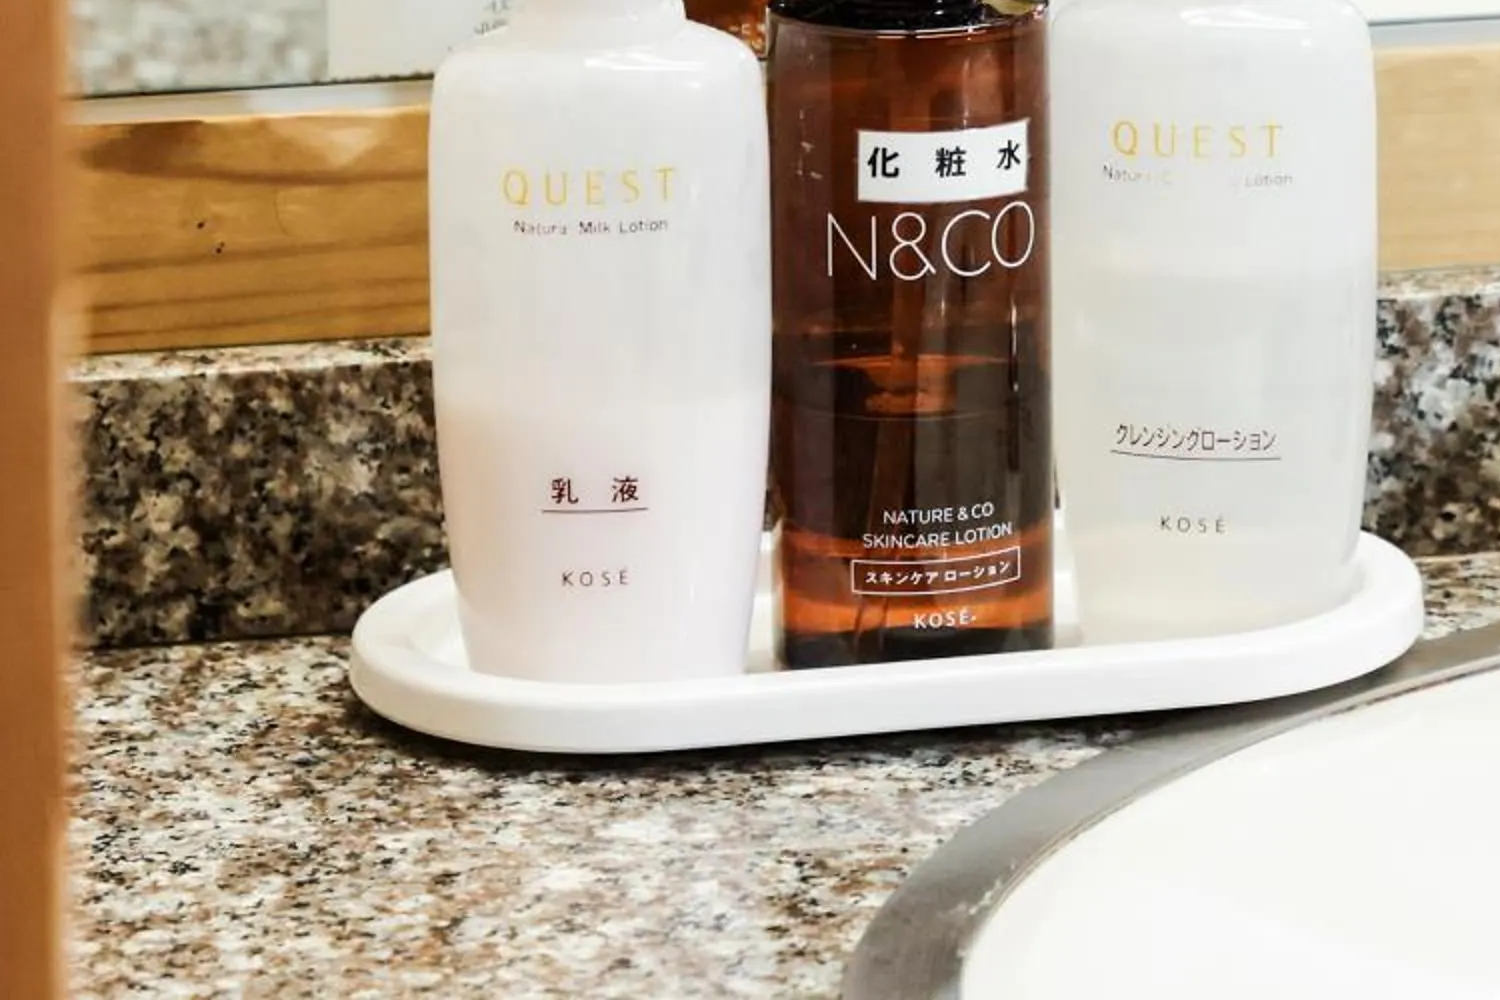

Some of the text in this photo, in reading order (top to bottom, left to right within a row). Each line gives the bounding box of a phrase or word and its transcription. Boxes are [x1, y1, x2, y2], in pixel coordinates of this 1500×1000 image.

[1112, 119, 1283, 159] QUEST
[867, 140, 1021, 179] 化粧水
[1102, 163, 1157, 183] Natur
[502, 166, 675, 207] QUEST
[512, 218, 669, 236] Natura Milk Lotion
[827, 201, 1035, 281] N&CO
[550, 475, 640, 505] 乳液
[883, 501, 995, 525] NATURE & CO
[863, 520, 1013, 549] SKINCARE LOTION
